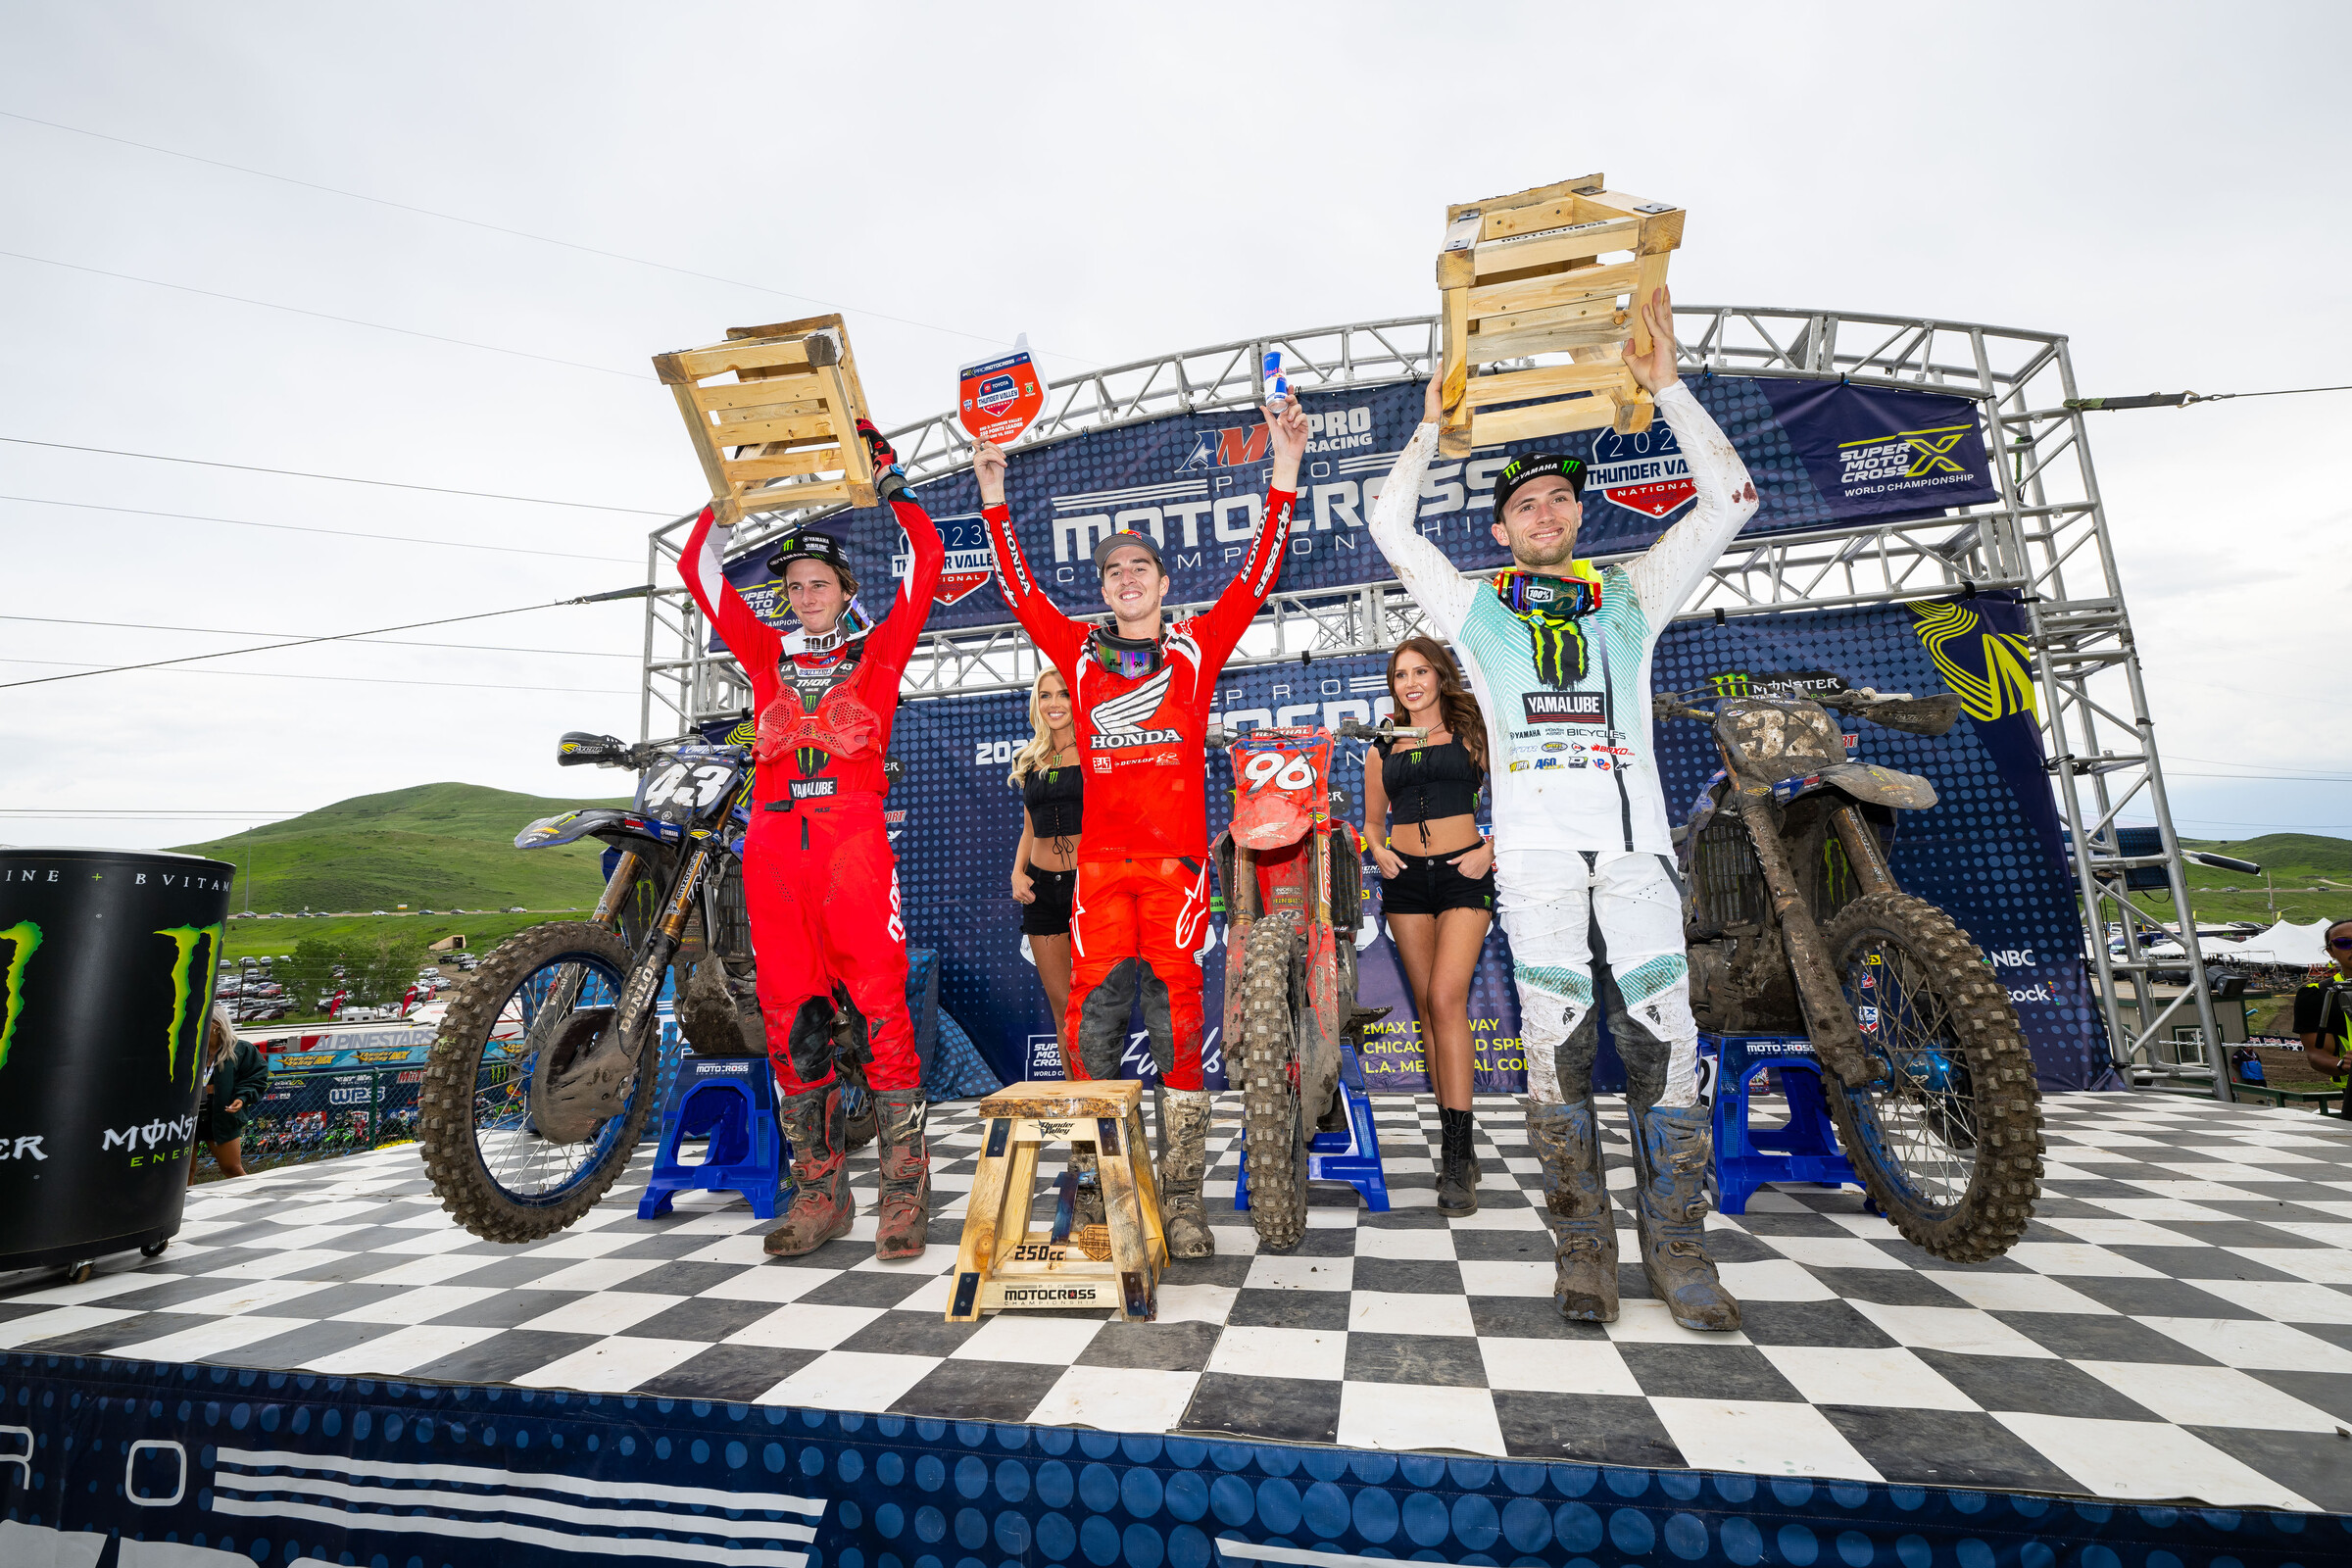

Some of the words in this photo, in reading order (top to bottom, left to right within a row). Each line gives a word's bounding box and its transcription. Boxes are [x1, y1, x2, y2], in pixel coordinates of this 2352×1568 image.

[992, 380, 1009, 389] TOYOTA
[978, 394, 1000, 405] THUNDER
[1000, 389, 1018, 400] VALLEY
[1308, 407, 1371, 438] PRO
[1174, 421, 1277, 473] AM
[1305, 432, 1372, 454] RACING
[1609, 429, 1675, 459] 202
[1839, 442, 1911, 463] SUPER
[1845, 454, 1908, 472] MOTO
[1518, 463, 1558, 481] YAMAHA
[1587, 463, 1661, 486] THUNDER
[1840, 465, 1911, 484] CROSS
[1844, 484, 1886, 497] WORLD
[1886, 473, 1975, 492] CHAMPIONSHIP
[1240, 503, 1272, 584] HONDA
[955, 553, 993, 569] VALLE
[1002, 519, 1032, 598] HONDA
[943, 573, 981, 583] IONAL
[740, 590, 775, 600] UPER
[1529, 589, 1550, 600] 100%
[796, 678, 832, 687] THOR
[1527, 696, 1600, 713] YAMALUBE
[1090, 728, 1183, 751] HONDA
[1515, 729, 1542, 740] YAMAHA
[1566, 728, 1627, 740] BICYCLES
[1736, 709, 1829, 762] 32
[976, 740, 1031, 765] 202
[1599, 746, 1629, 756] BOXO
[1120, 757, 1154, 766] DUNLOP
[1245, 752, 1318, 796] 96
[644, 761, 733, 808] 43
[792, 782, 834, 799] YAMALUBE
[1991, 949, 2035, 967] NBC
[620, 955, 658, 1035] DUNLOP
[2009, 984, 2051, 1003] cock
[1363, 1021, 1407, 1035] zMAX
[314, 1030, 439, 1051] ALPINESTARS
[314, 1055, 336, 1065] MX
[388, 1051, 412, 1060] MX
[1365, 1060, 1396, 1074] L.A.
[330, 1087, 385, 1104] WPS
[1040, 1120, 1076, 1129] Thunder
[1014, 1245, 1065, 1261] 250cc
[1004, 1289, 1097, 1300] MOTOCROSS
